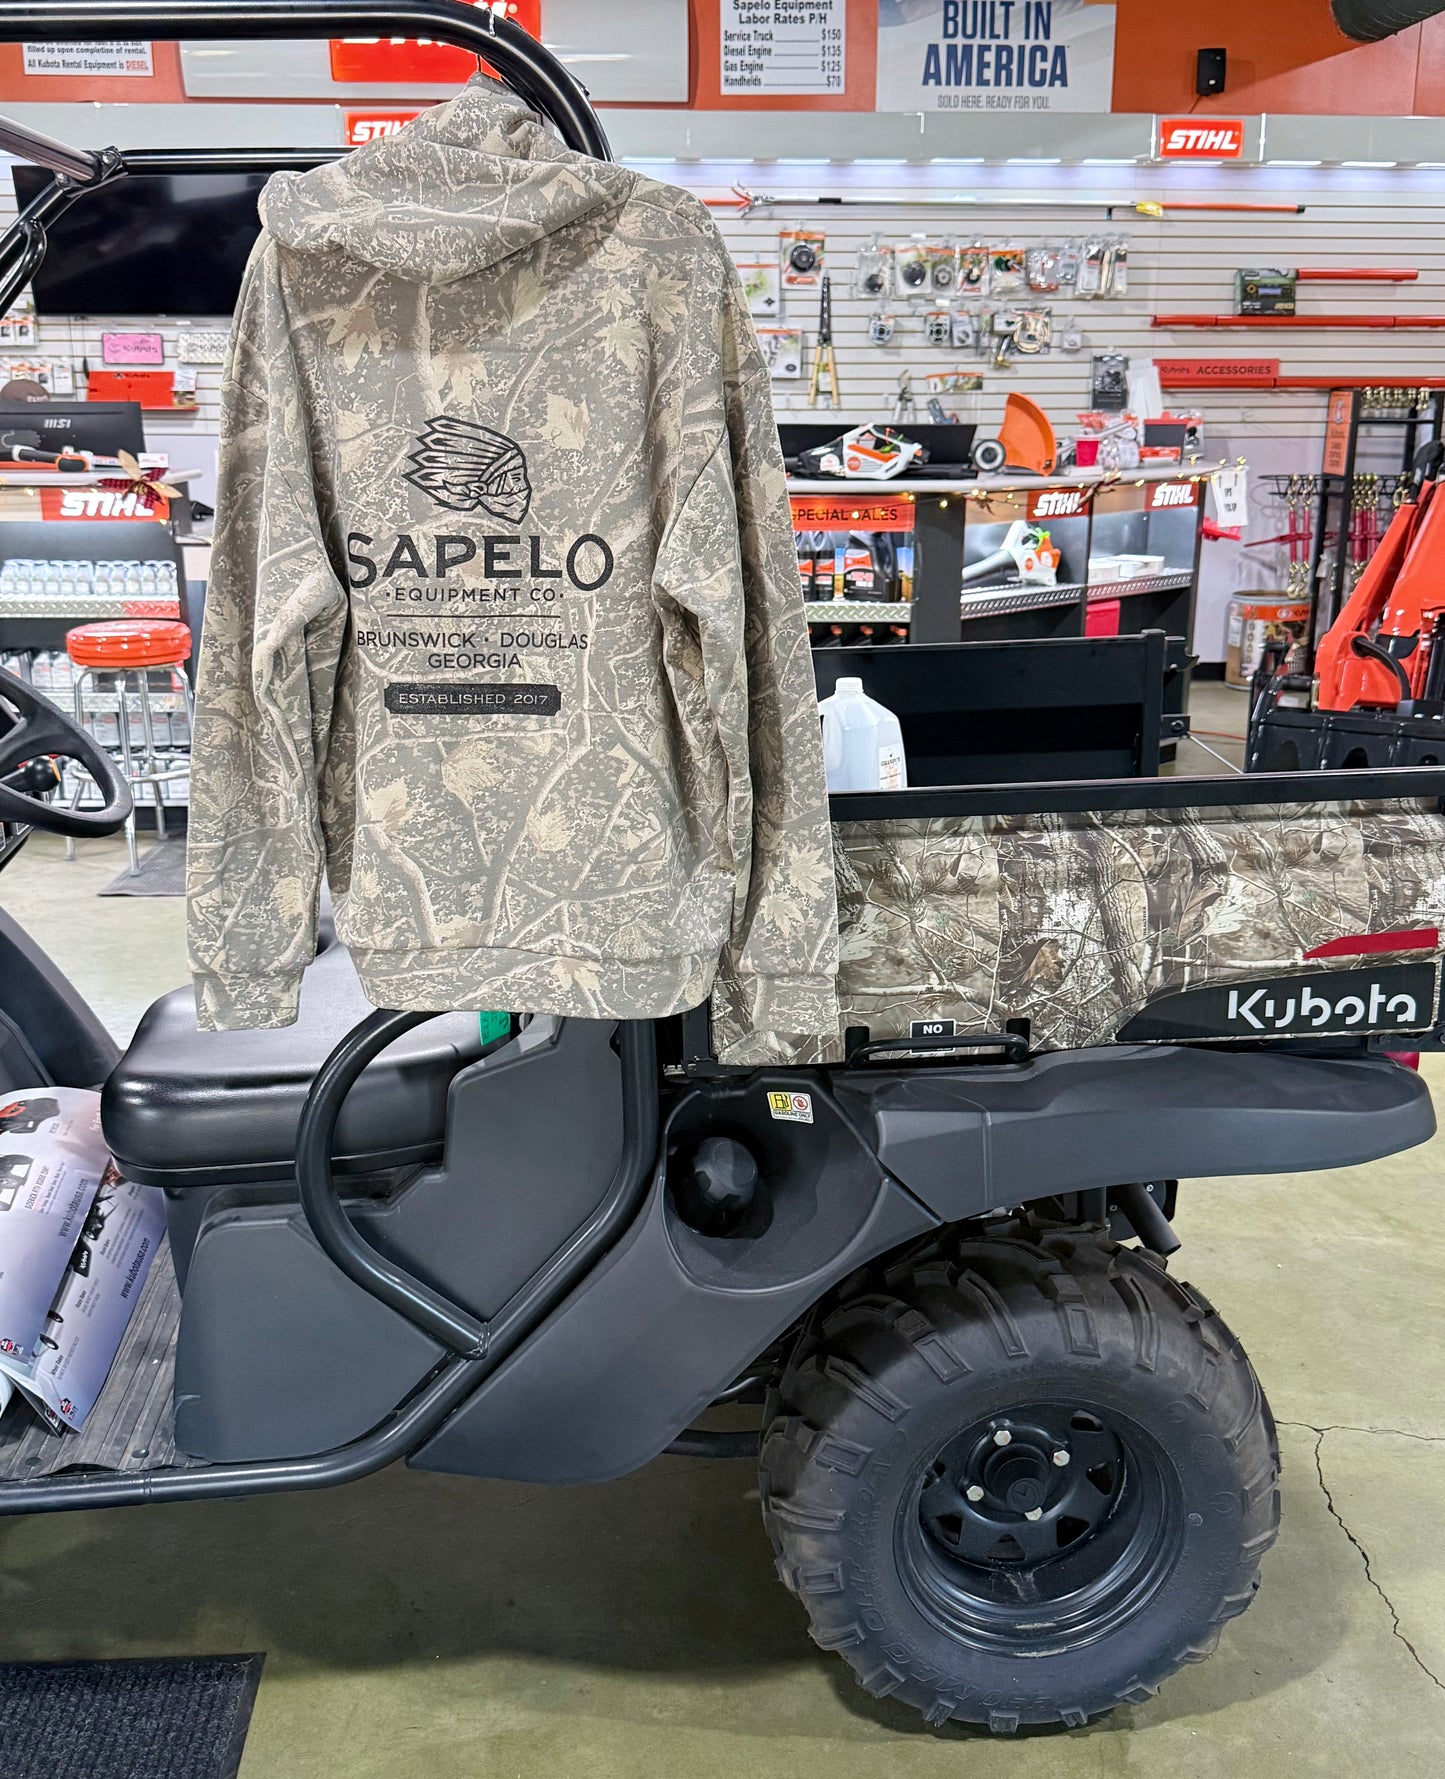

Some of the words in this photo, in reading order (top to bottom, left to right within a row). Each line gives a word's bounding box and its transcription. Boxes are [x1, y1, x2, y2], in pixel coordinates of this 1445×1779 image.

[733, 0, 772, 12] Sapelo
[775, 0, 833, 12] Equipment
[738, 13, 770, 24] Labor
[774, 13, 805, 24] Rates
[808, 13, 827, 24] P/H
[942, 0, 1010, 40] BUILT
[1024, 0, 1051, 40] IN
[724, 30, 750, 42] Service
[753, 30, 773, 41] Truck
[821, 29, 841, 41] $150
[724, 45, 746, 56] Diesel
[748, 45, 772, 59] Engine
[38, 60, 60, 68] Kubota
[62, 60, 82, 68] Rental
[84, 60, 116, 71] Equipment
[724, 60, 738, 72] Gas
[740, 60, 764, 74] Engine
[922, 44, 1069, 88] AMERICA
[724, 75, 761, 87] Handhelds
[826, 75, 841, 87] $70
[938, 95, 959, 109] SOLD
[986, 95, 1011, 109] READY
[1013, 95, 1031, 109] FOR
[1166, 130, 1238, 150] STIHL
[1196, 365, 1272, 375] ACCESSORIES
[1151, 484, 1194, 507] STIHL
[347, 532, 614, 592] SAPELO
[357, 630, 475, 649] BRUNSWICK
[500, 632, 588, 650] DOUGLAS
[428, 653, 522, 669] GEORGIA
[398, 694, 506, 705] ESTABLISHED
[513, 694, 548, 705] 2017
[1227, 983, 1417, 1029] Kubota
[922, 1024, 943, 1035] NO
[58, 1178, 90, 1238] www.kubotausa.com
[120, 1236, 150, 1300] www.kubotausa.com
